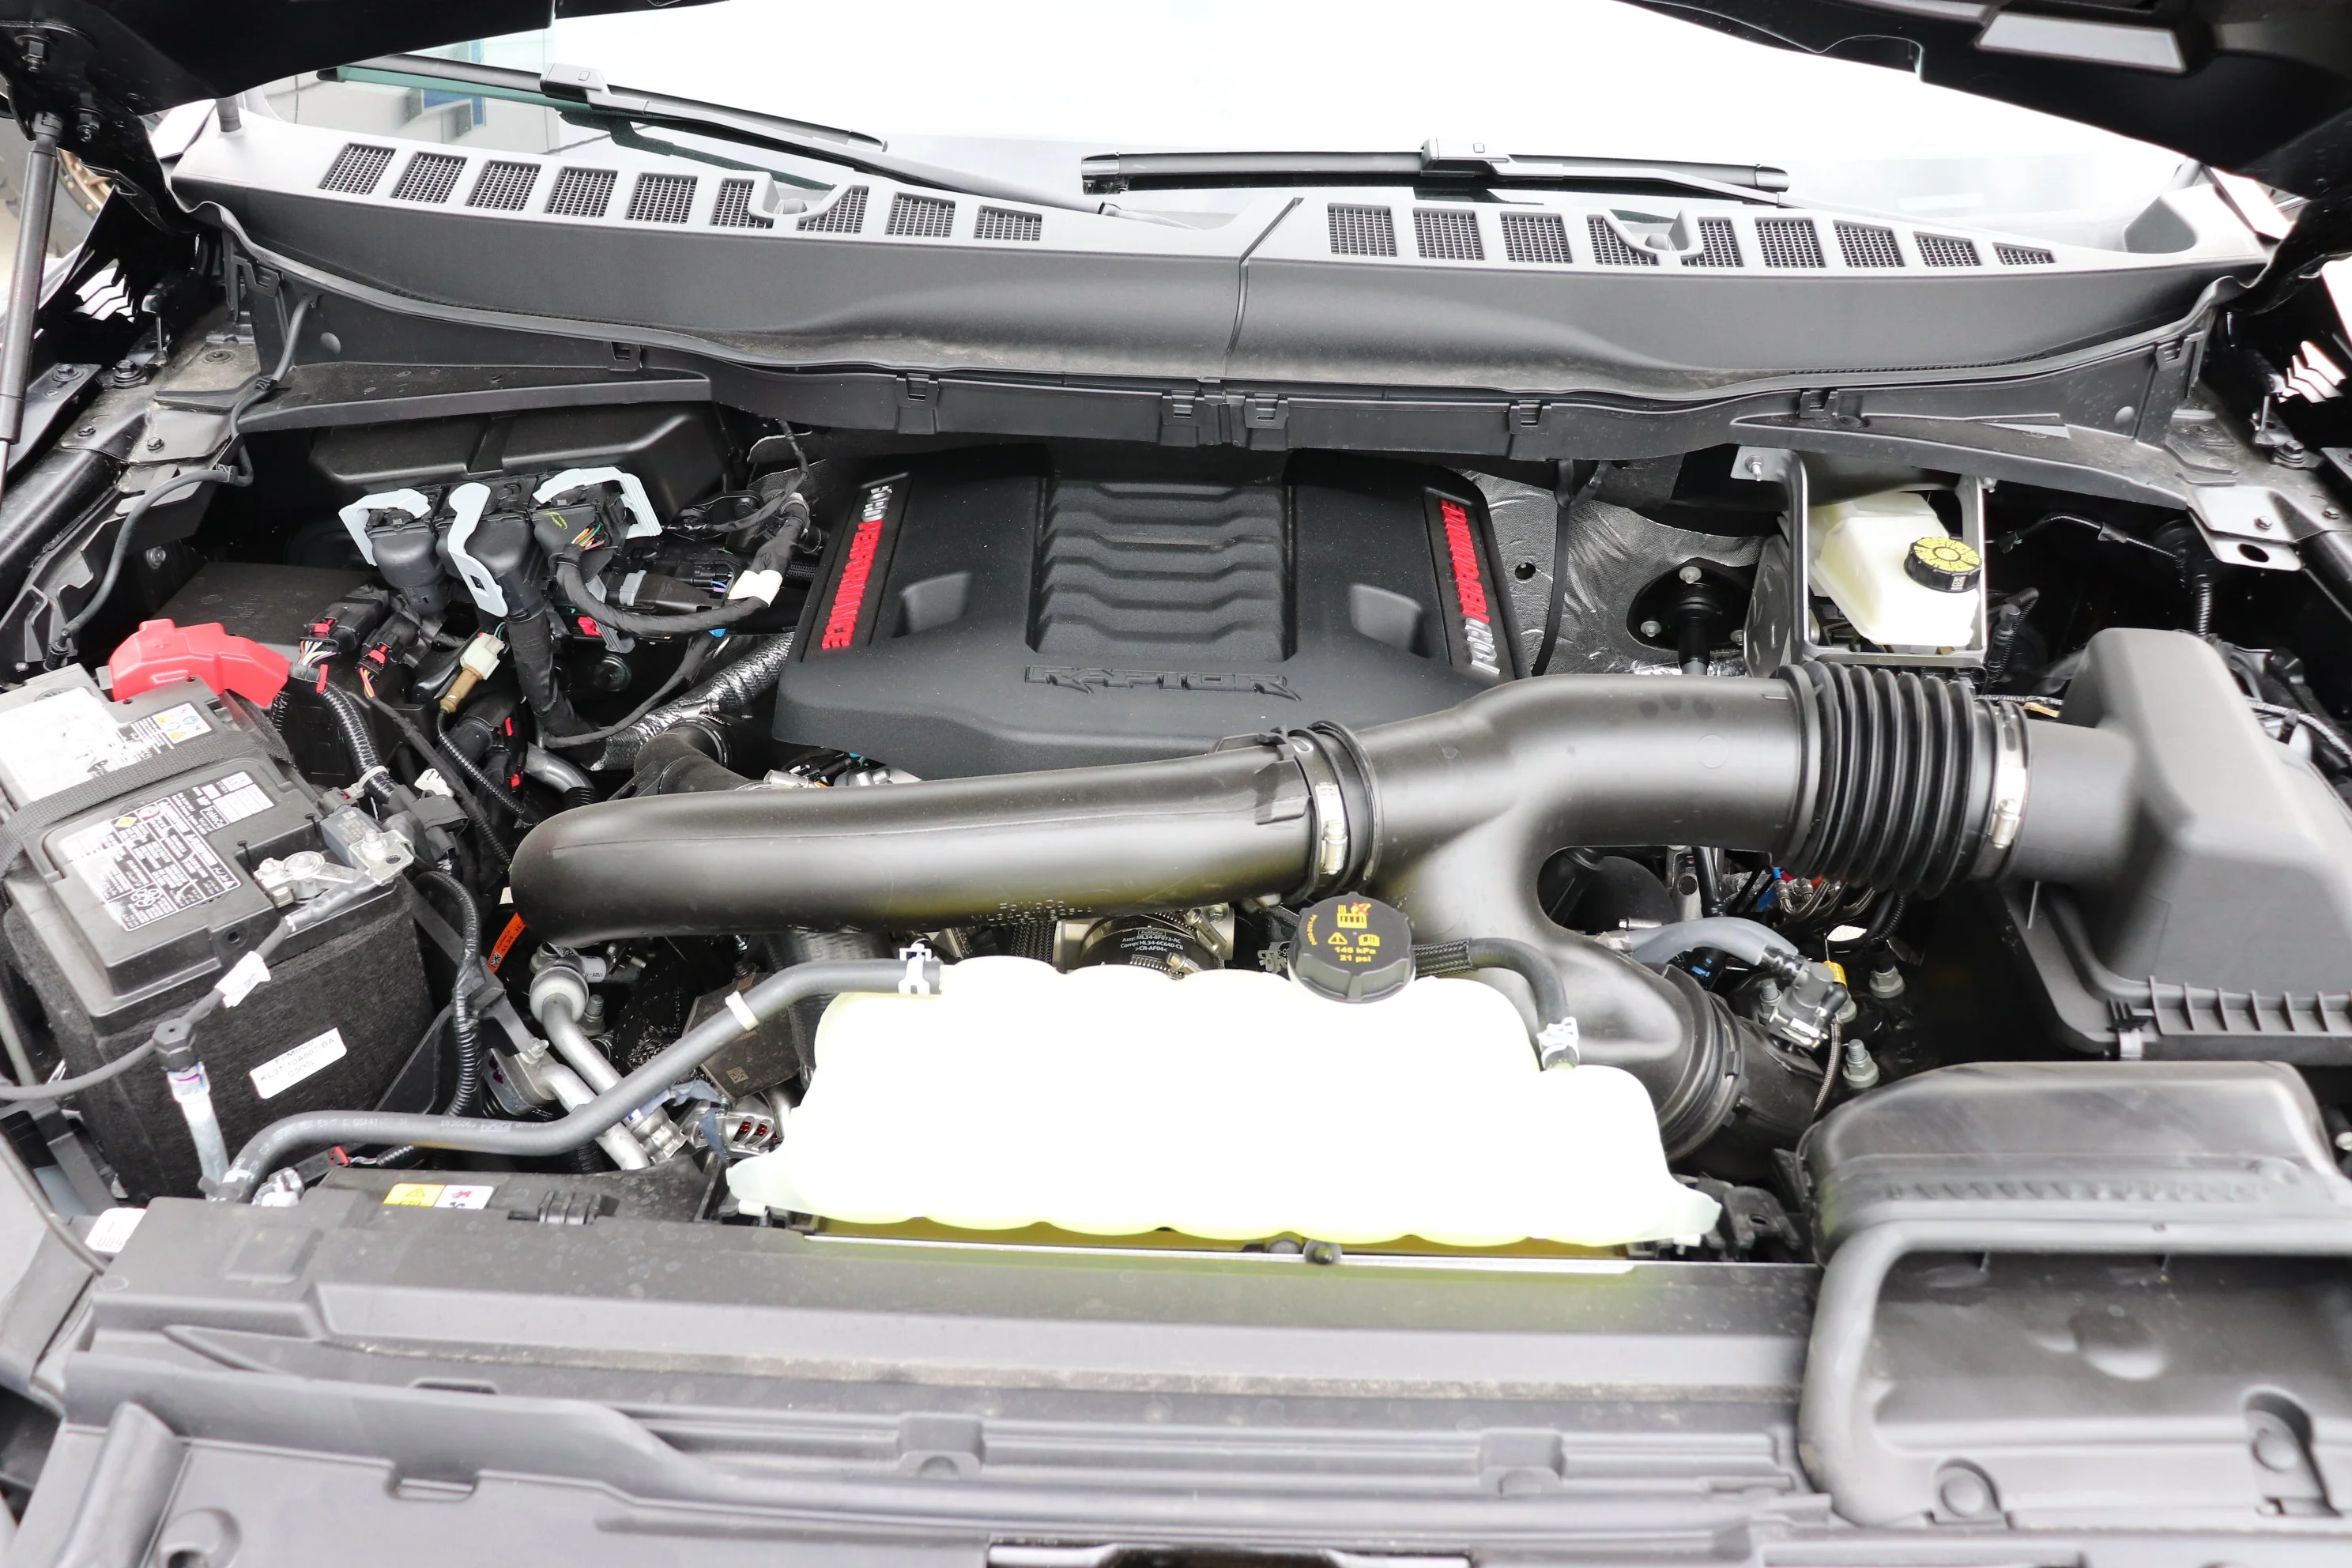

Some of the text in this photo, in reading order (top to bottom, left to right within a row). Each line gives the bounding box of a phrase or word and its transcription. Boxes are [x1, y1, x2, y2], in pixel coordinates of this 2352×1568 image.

[822, 518, 884, 649] PERFORMANCE
[1441, 499, 1501, 675] FORD PERFORMANCE
[1024, 665, 1302, 702] RAPTOR
